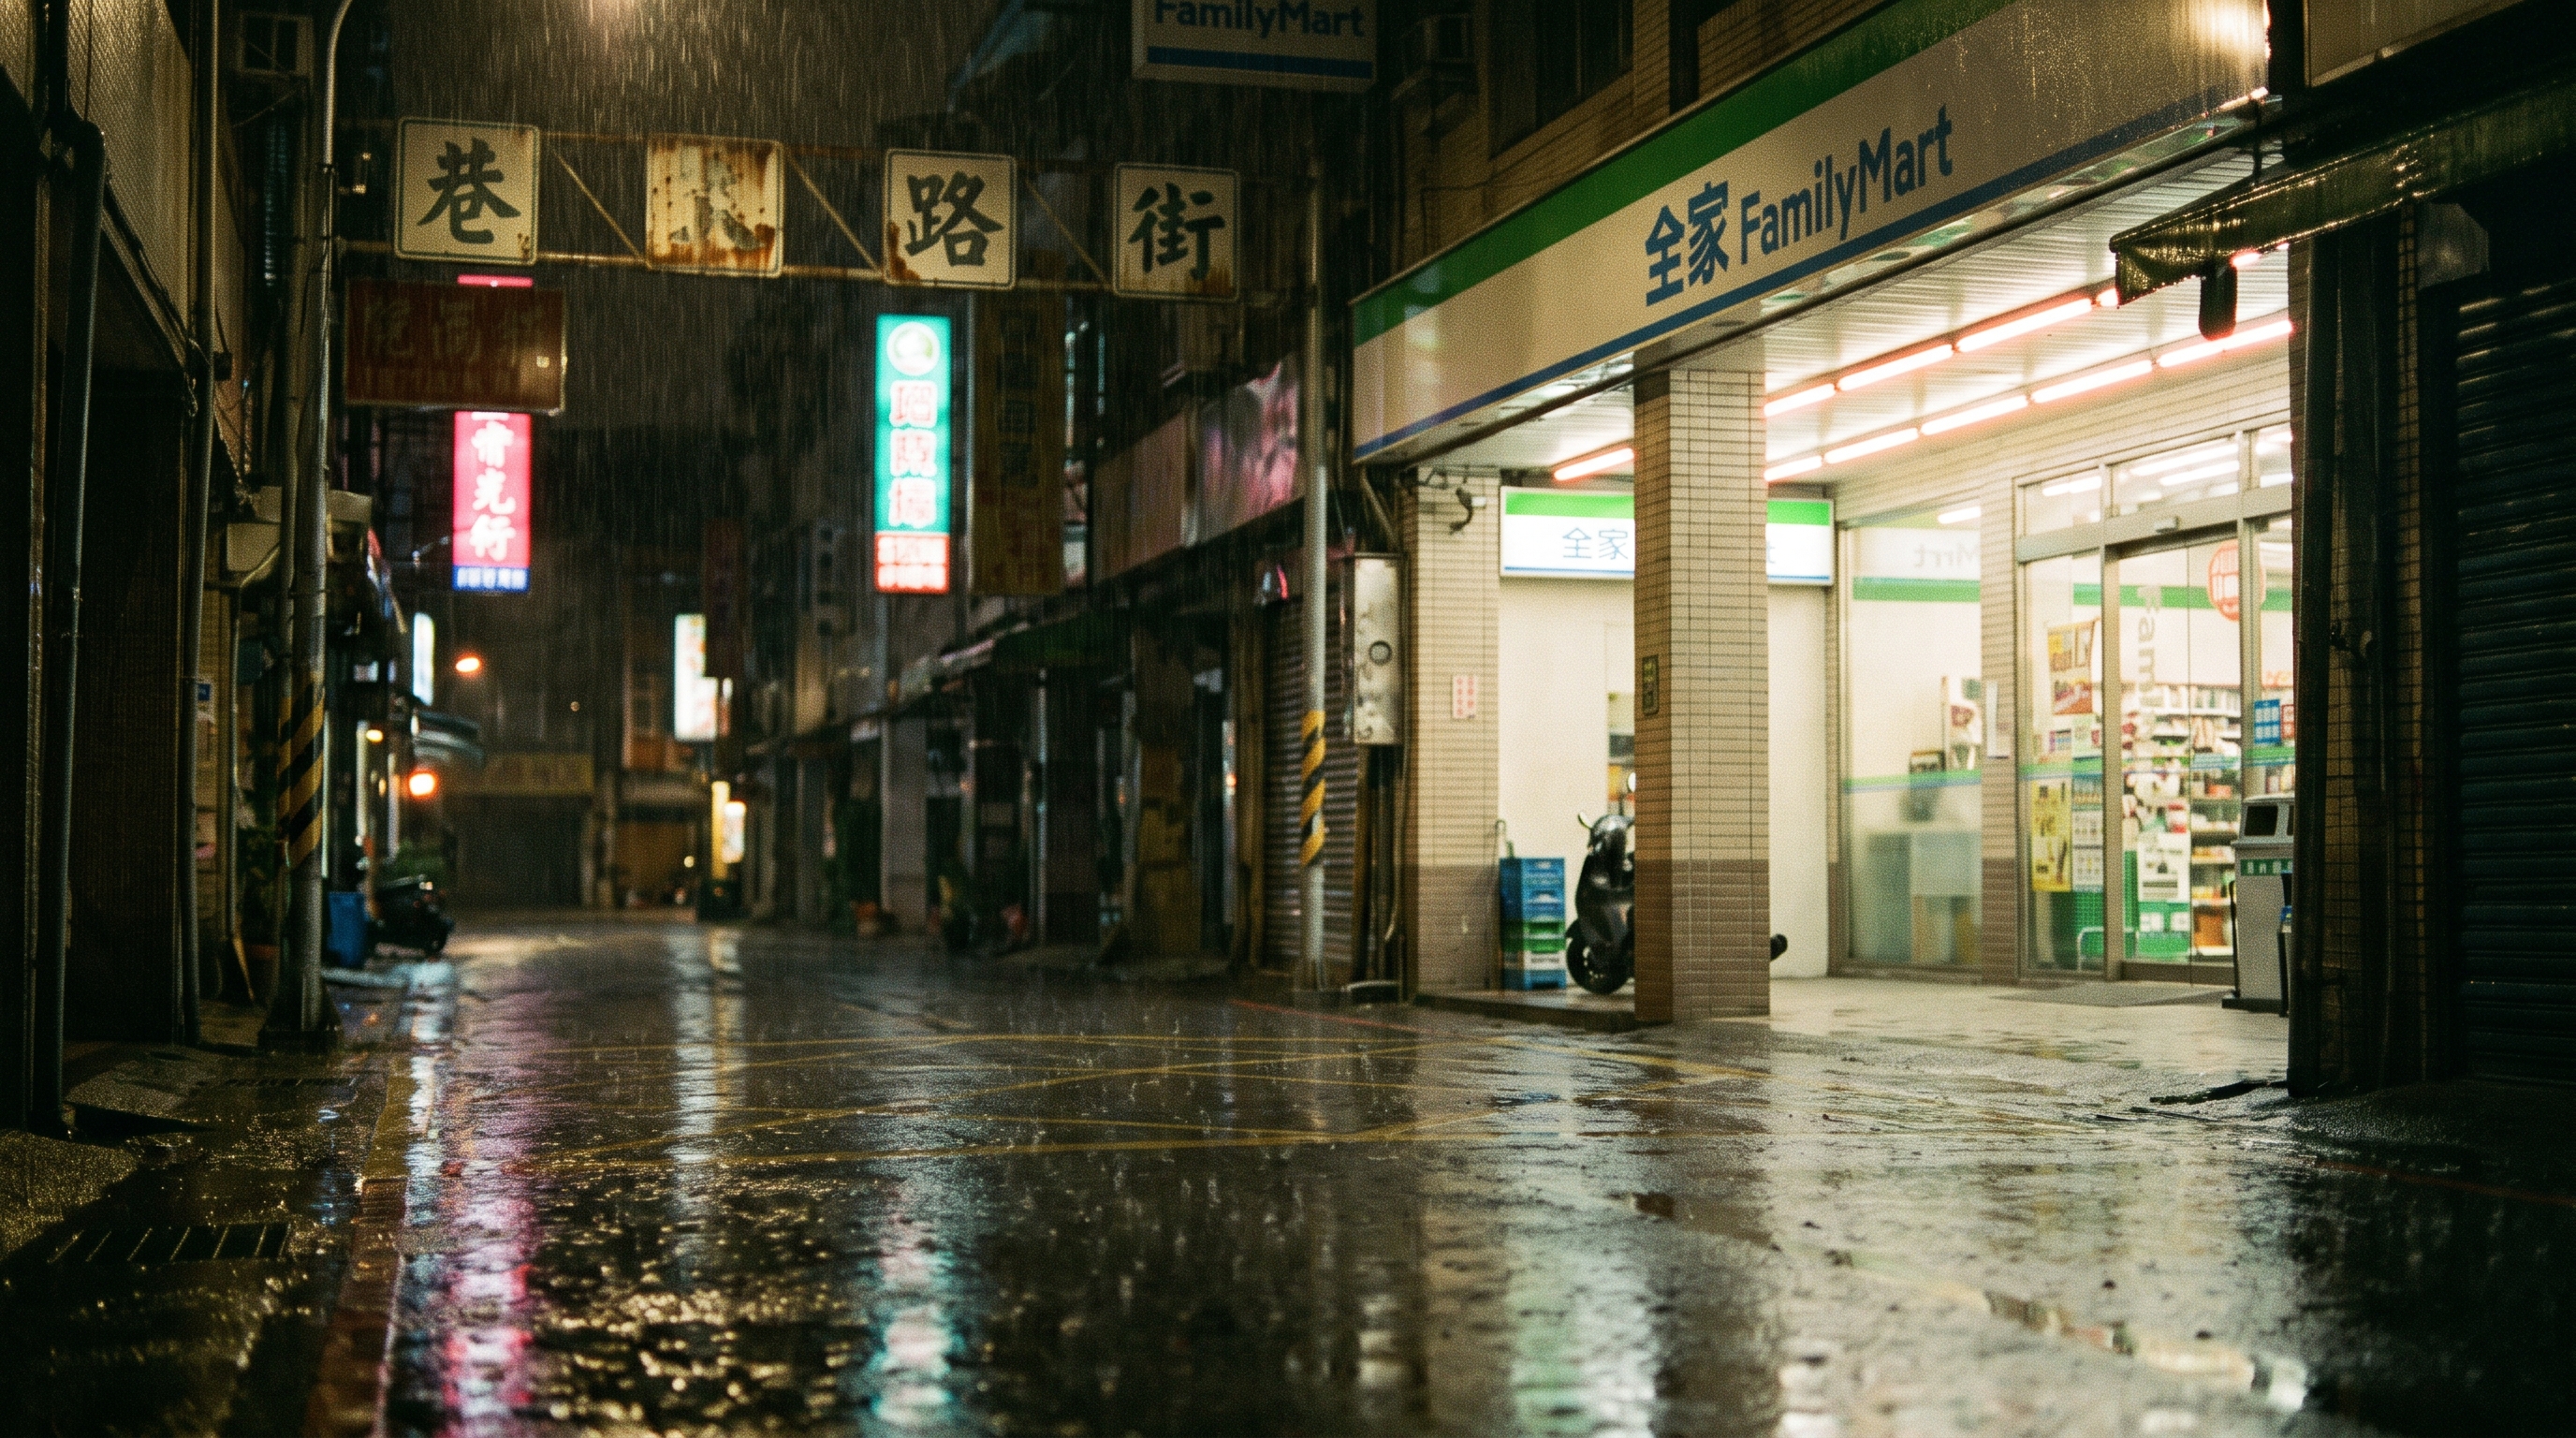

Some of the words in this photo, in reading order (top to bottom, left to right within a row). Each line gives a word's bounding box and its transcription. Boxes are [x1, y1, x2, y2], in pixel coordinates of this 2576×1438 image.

[1155, 0, 1364, 38] FamilyMart
[417, 137, 521, 244] 巷
[904, 170, 1004, 267] 路
[1128, 183, 1225, 280] 街
[1645, 180, 1730, 307] 全家
[1740, 103, 1954, 266] FamilyMart
[1562, 527, 1630, 561] 全家
